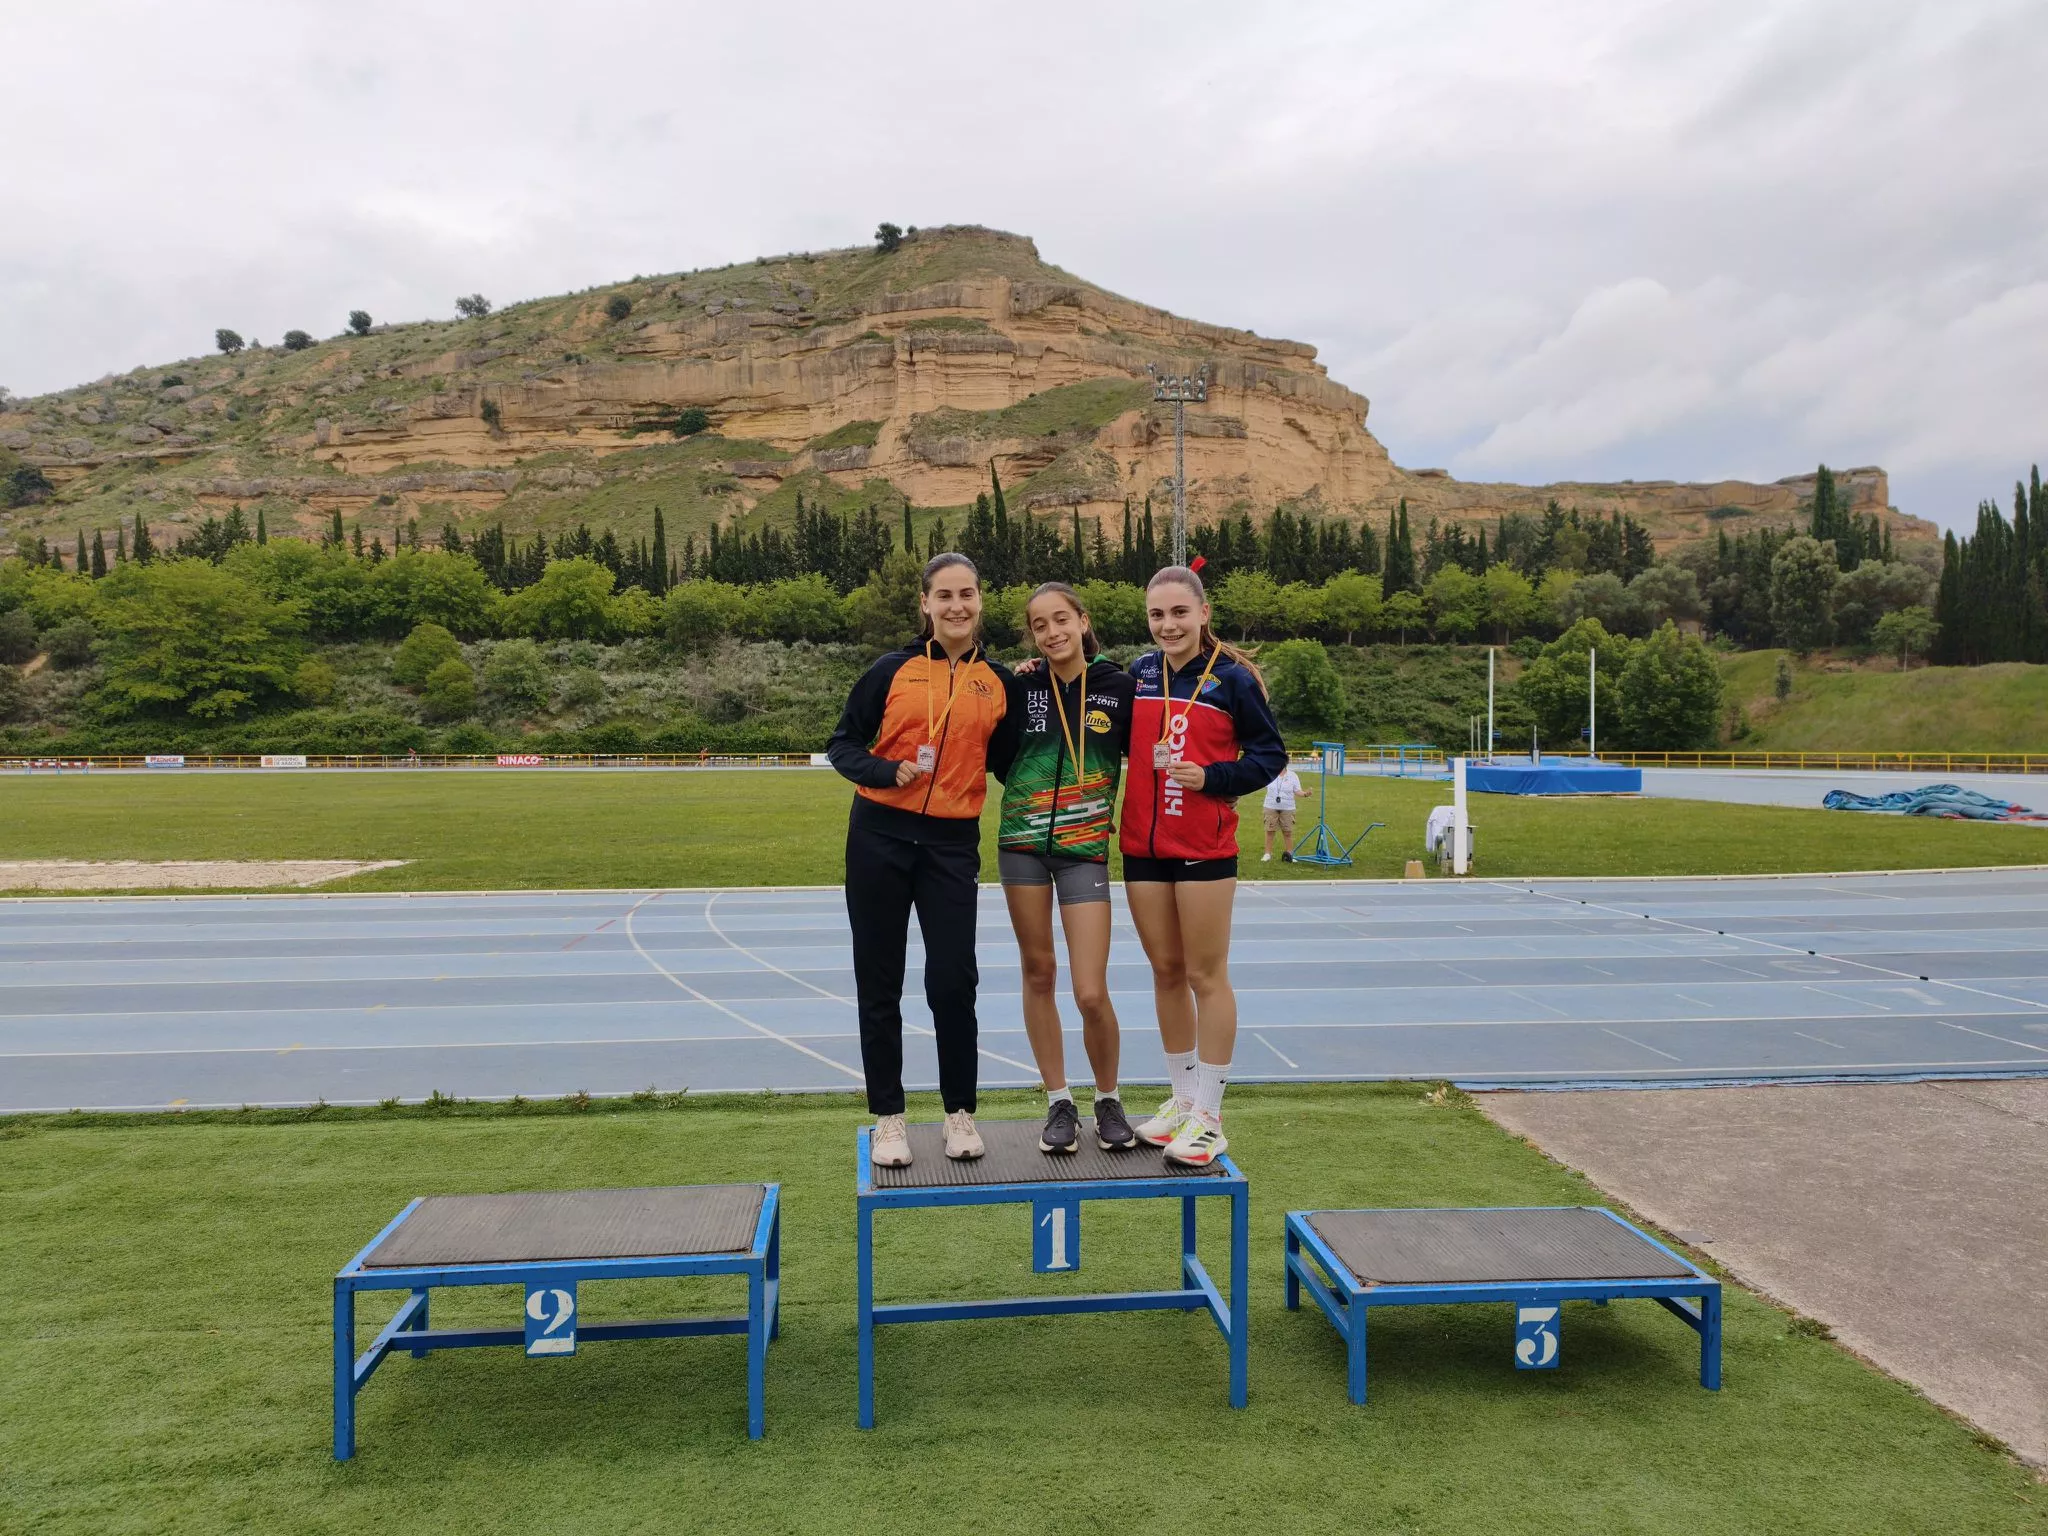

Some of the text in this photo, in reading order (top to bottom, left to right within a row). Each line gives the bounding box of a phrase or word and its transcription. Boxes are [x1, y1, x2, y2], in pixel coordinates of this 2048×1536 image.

[498, 756, 539, 765] HINACO
[1040, 1207, 1071, 1269] 1
[526, 1289, 575, 1355] 2
[1516, 1307, 1558, 1366] 3
